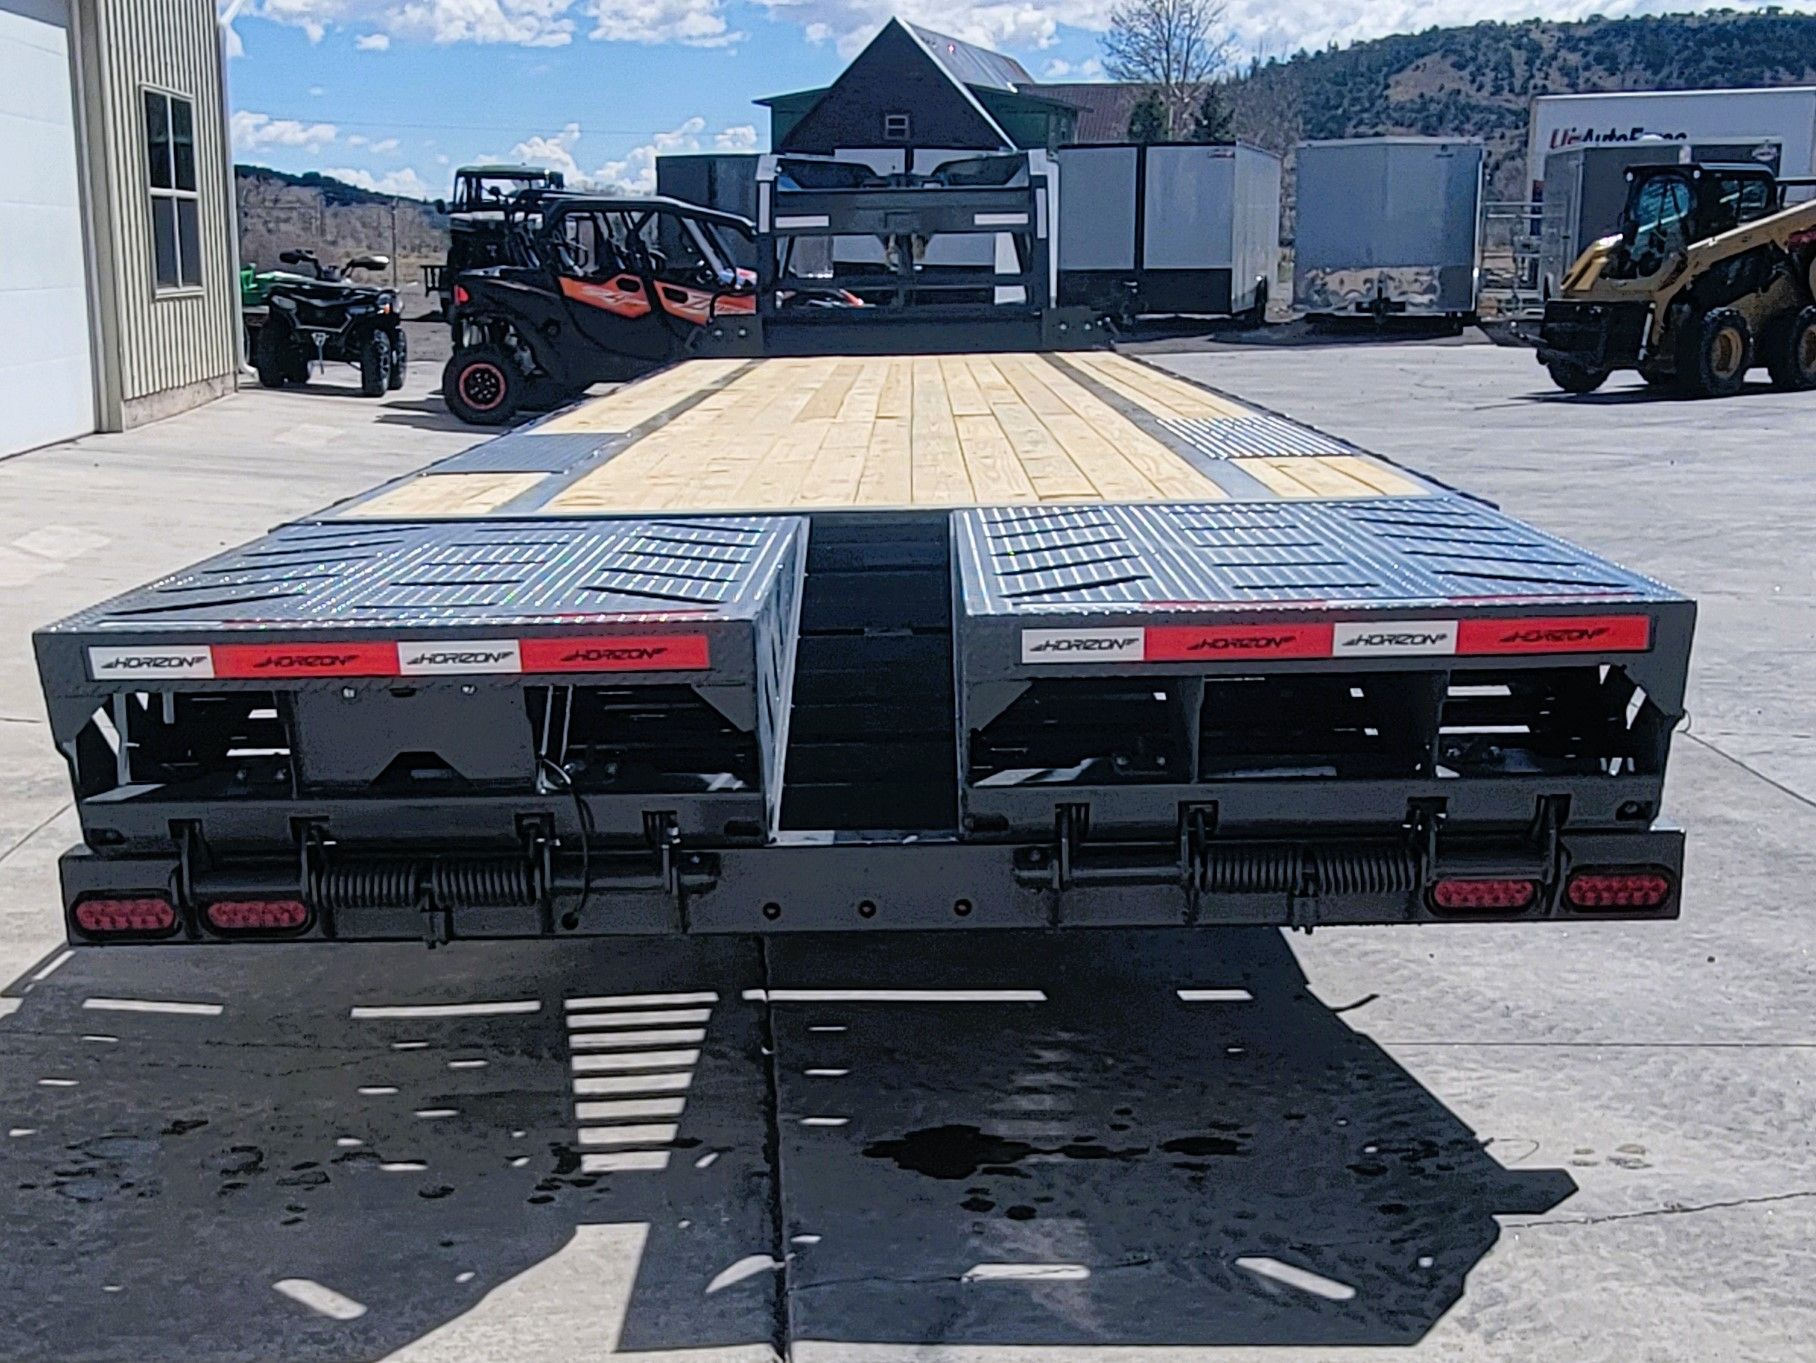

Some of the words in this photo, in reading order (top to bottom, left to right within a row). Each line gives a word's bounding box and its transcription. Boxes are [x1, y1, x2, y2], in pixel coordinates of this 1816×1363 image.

[1031, 636, 1139, 652] HORIZON
[1188, 636, 1296, 650] HORIZON
[1343, 632, 1447, 646] HORIZON
[253, 655, 358, 668] HORIZON
[408, 652, 513, 665] HORIZON
[561, 647, 667, 662] HORIZON
[104, 655, 206, 669] HORIZON
